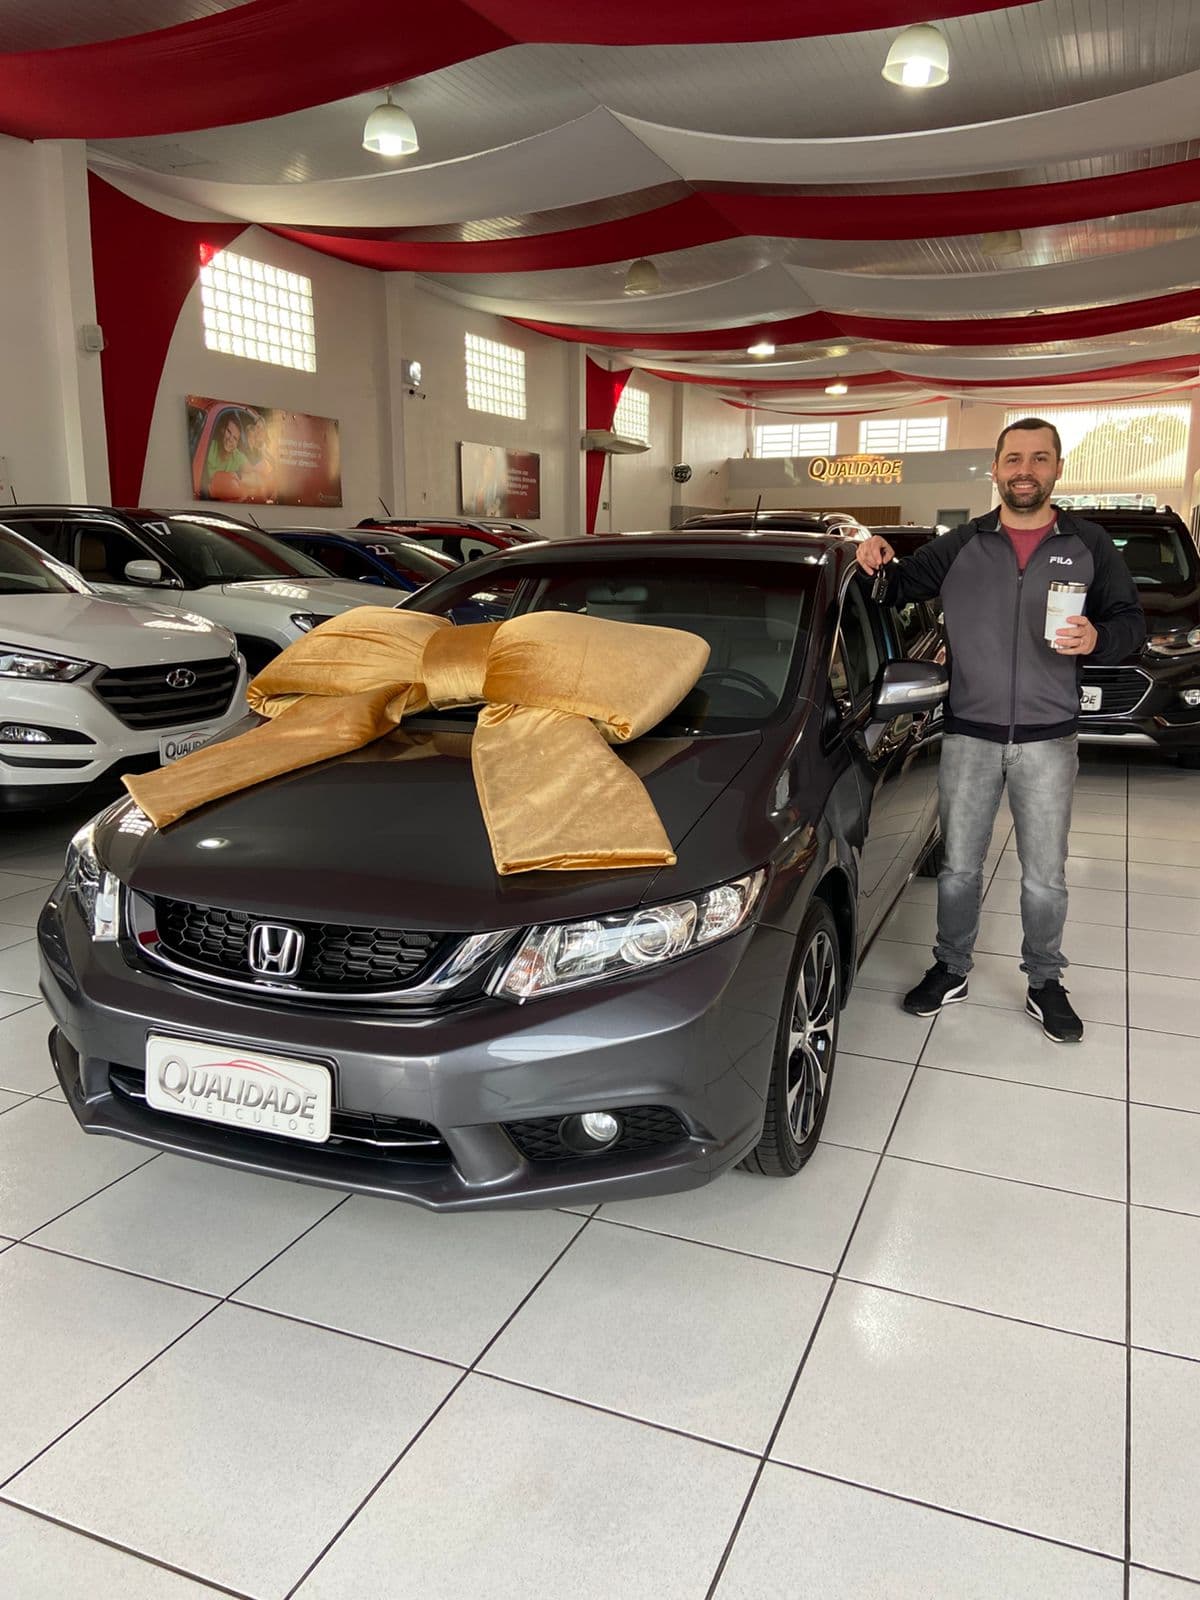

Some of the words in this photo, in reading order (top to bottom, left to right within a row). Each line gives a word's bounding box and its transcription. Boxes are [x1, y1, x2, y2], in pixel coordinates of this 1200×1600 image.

[808, 457, 903, 481] QUALIDADE
[142, 521, 172, 536] 17
[1049, 556, 1074, 566] FILA
[158, 1055, 317, 1118] QUALIDADE
